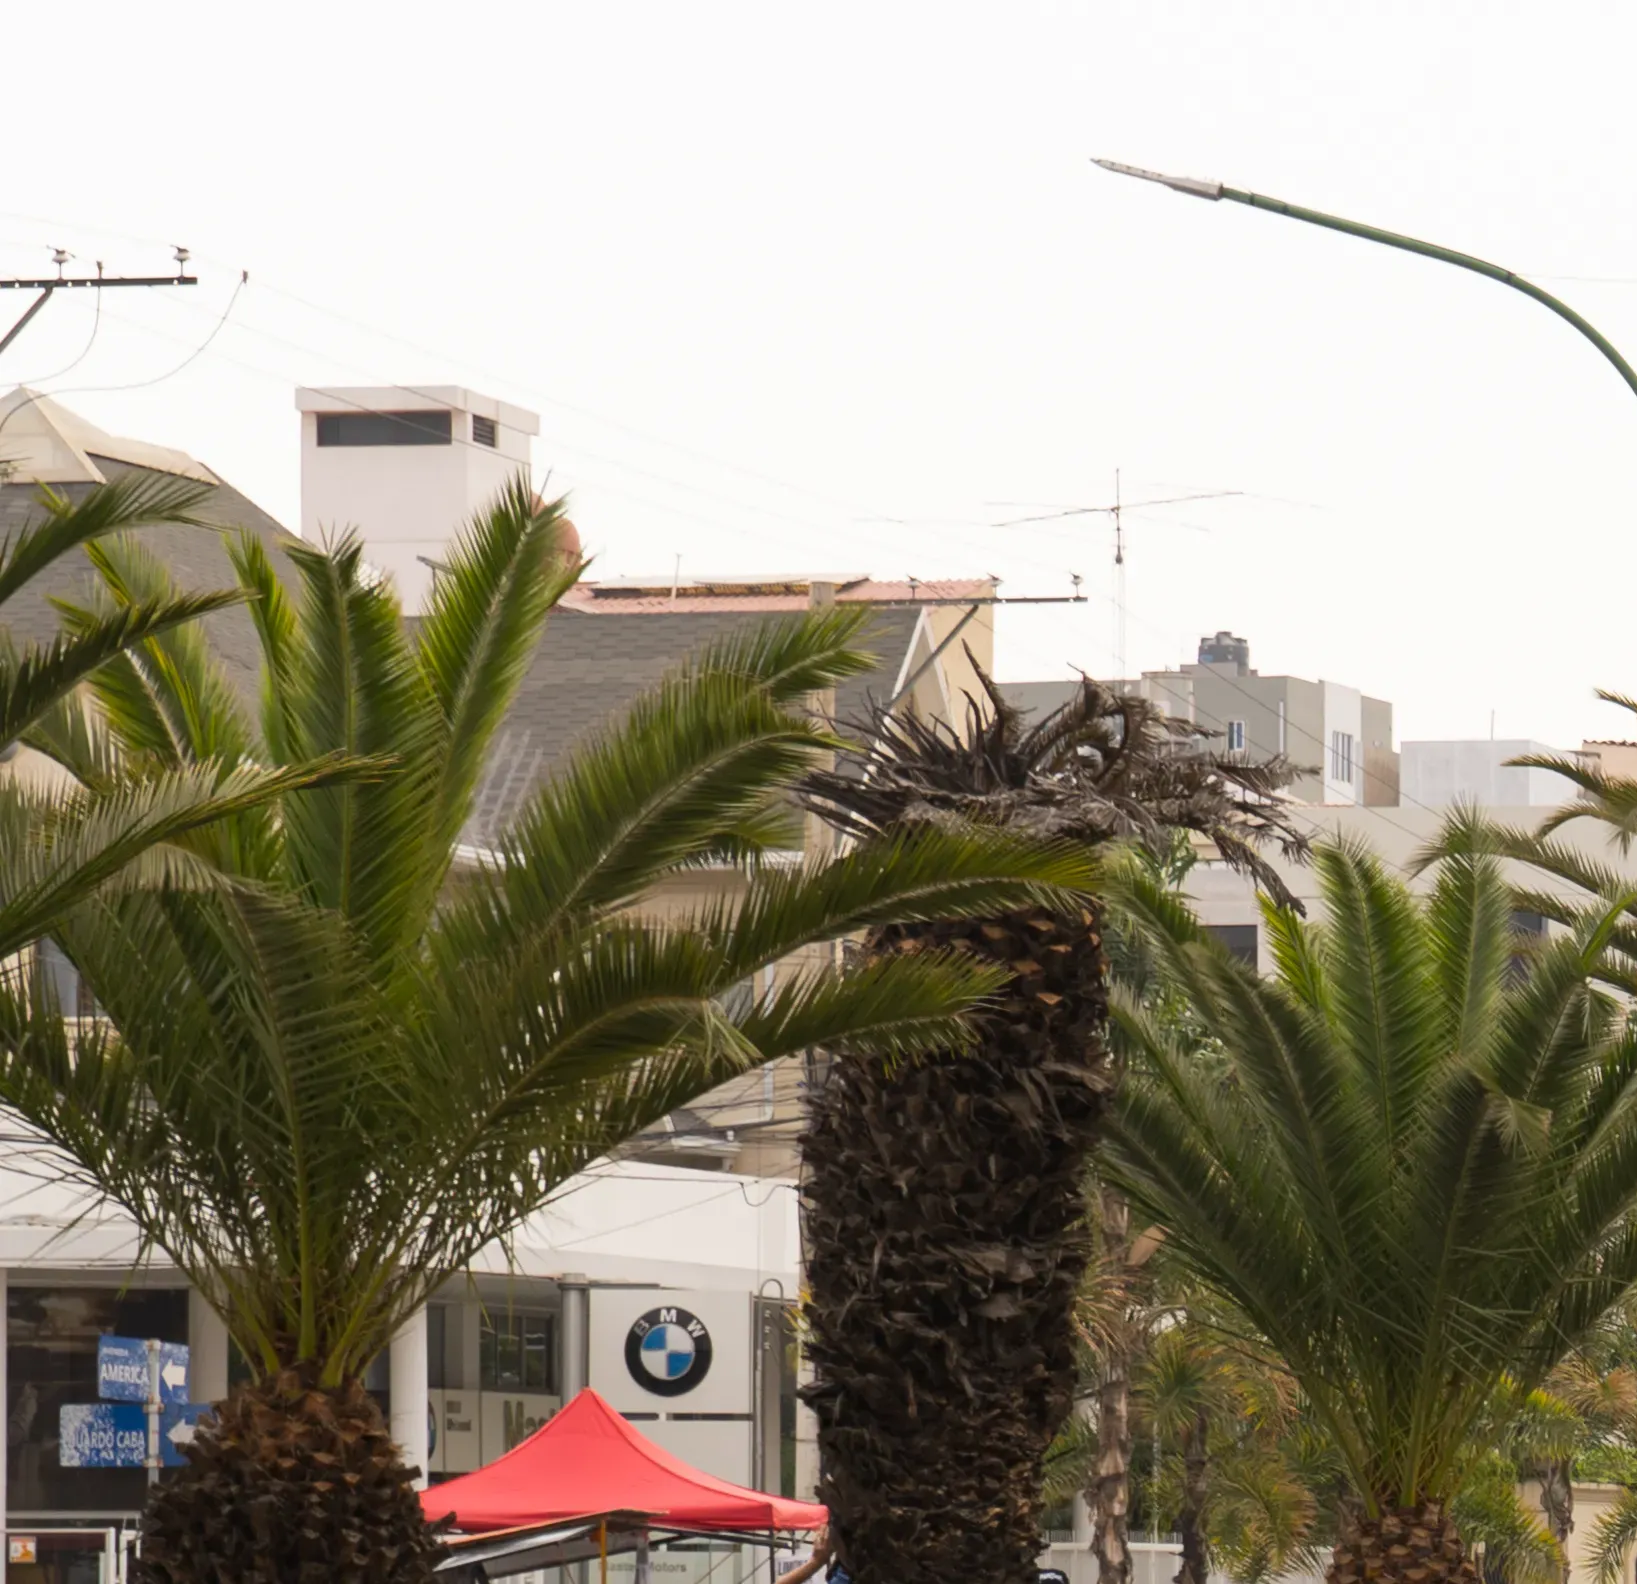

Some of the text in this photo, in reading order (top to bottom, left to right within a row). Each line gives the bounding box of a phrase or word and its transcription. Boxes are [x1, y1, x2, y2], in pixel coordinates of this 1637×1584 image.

[634, 1308, 705, 1338] BMW
[101, 1363, 149, 1384] AMERICA
[116, 1431, 145, 1448] CABA
